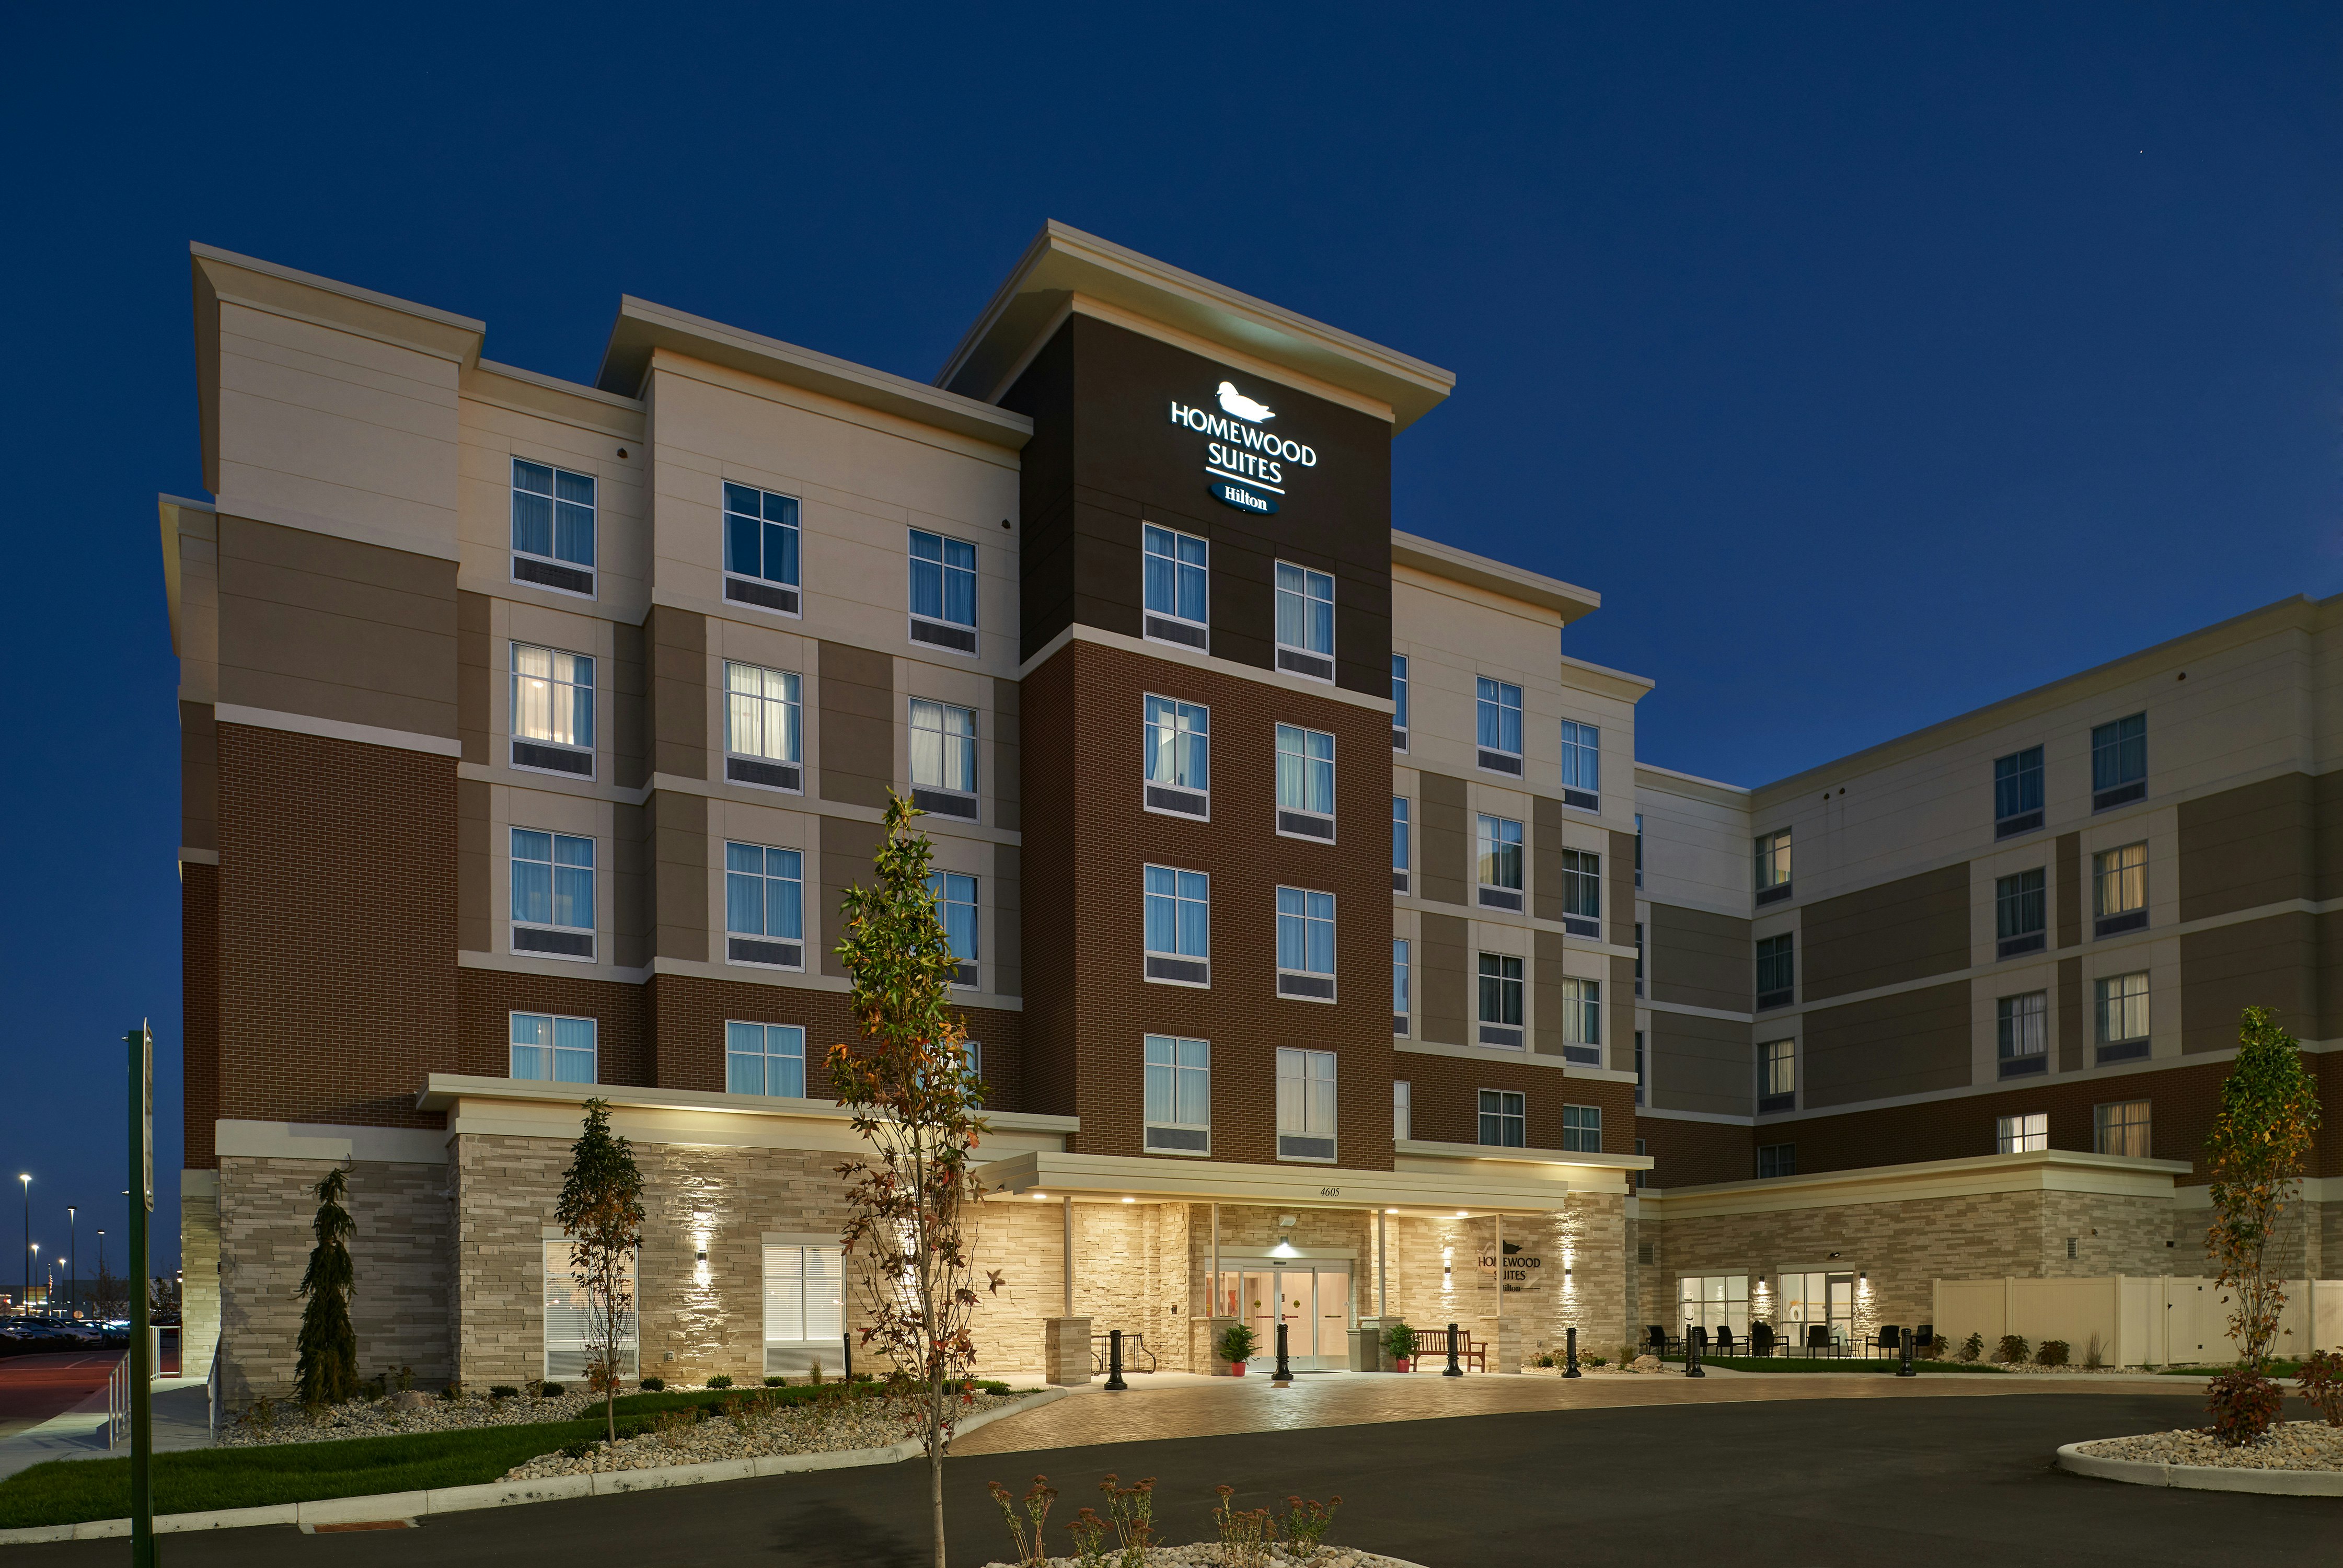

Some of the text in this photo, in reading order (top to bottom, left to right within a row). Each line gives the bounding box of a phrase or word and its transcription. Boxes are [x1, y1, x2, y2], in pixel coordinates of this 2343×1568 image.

[1171, 401, 1317, 467] HOMEWOOD
[1208, 442, 1282, 483] SUITES
[1225, 485, 1268, 511] Hilton
[1320, 1187, 1340, 1196] 4605
